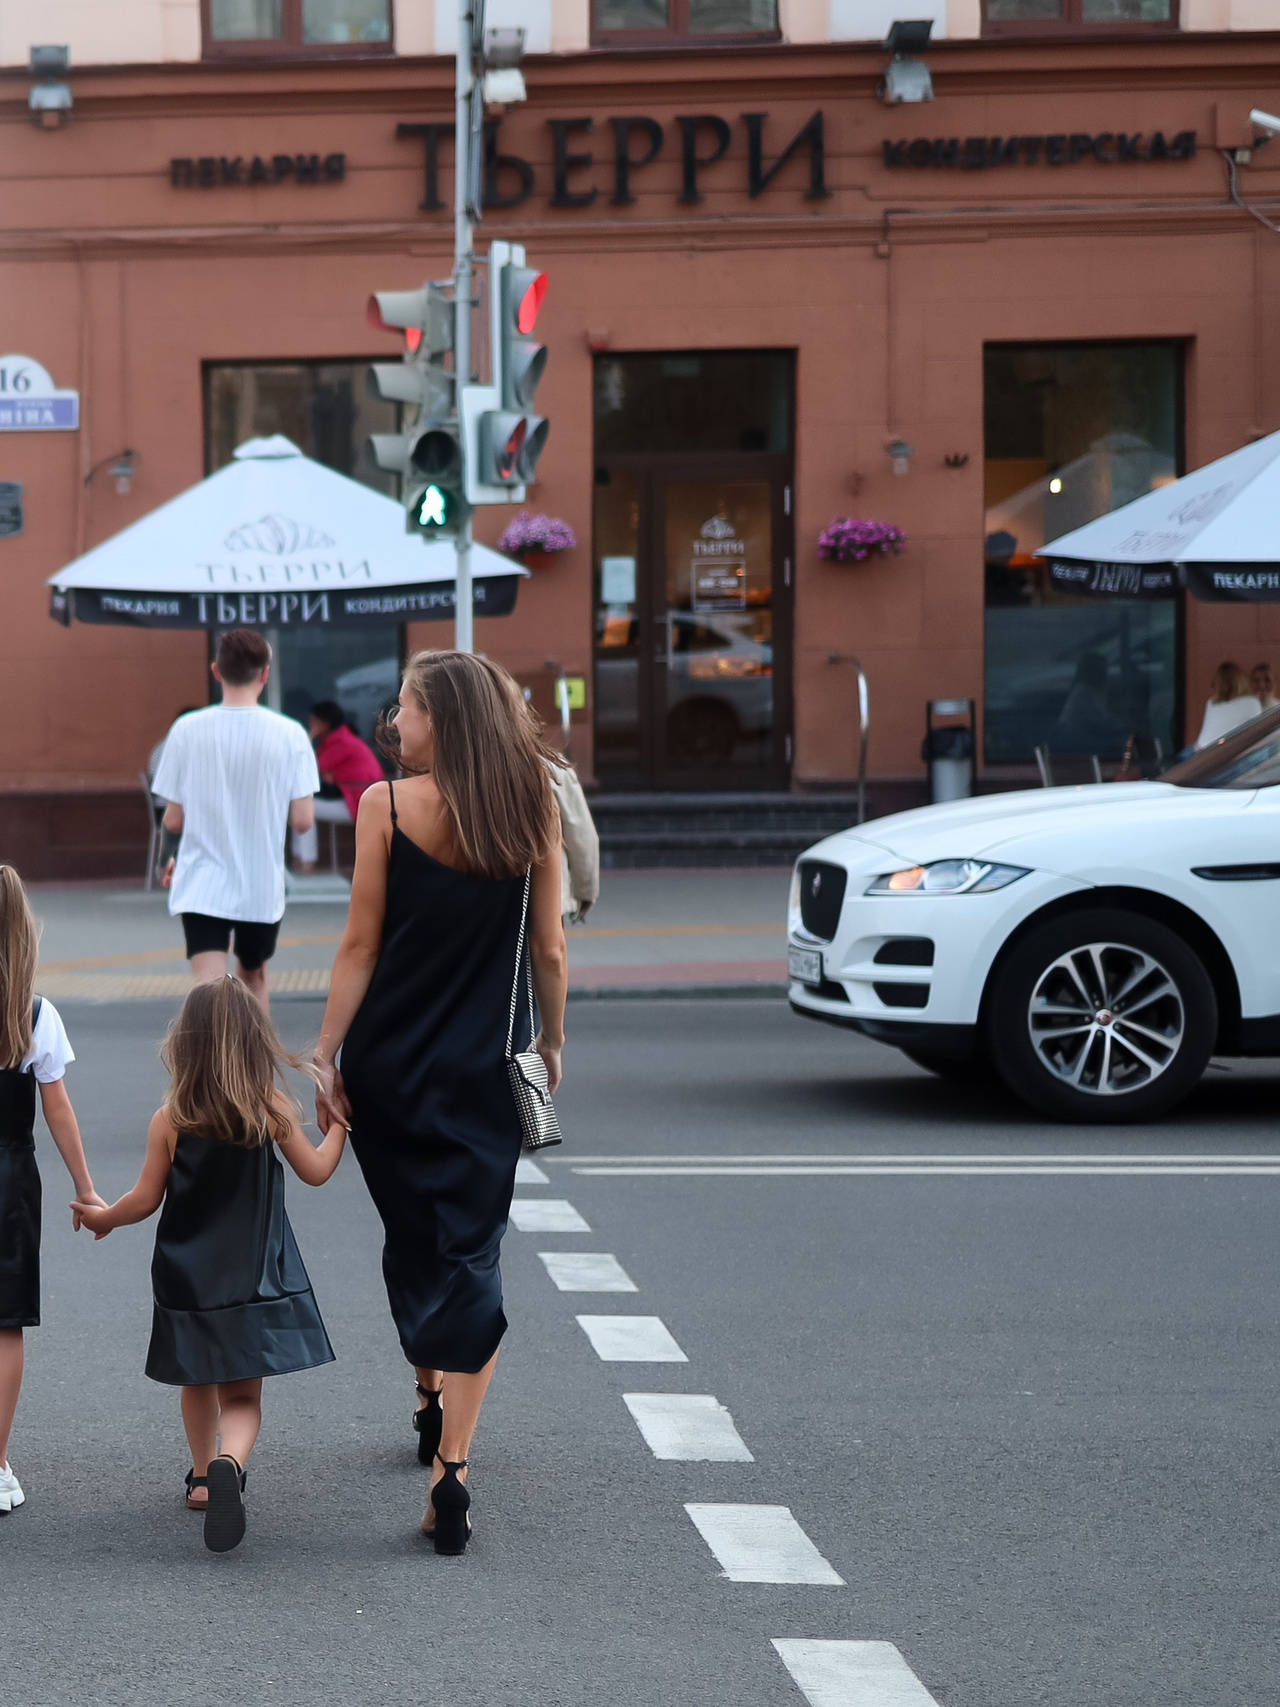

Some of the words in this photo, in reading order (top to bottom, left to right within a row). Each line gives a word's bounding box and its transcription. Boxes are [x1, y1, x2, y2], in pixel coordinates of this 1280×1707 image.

[170, 153, 347, 187] ПЕКАРНЯ
[394, 109, 833, 210] ТЬЕРРИ
[882, 131, 1197, 170] КОНДИТЕРСКАЯ
[195, 559, 372, 585] ТЬЕРРИ
[100, 595, 180, 617] ПЕКАРНЯ
[192, 592, 331, 624] ТЬЕРРИ
[344, 585, 486, 615] КОНДИТЕРСЯ
